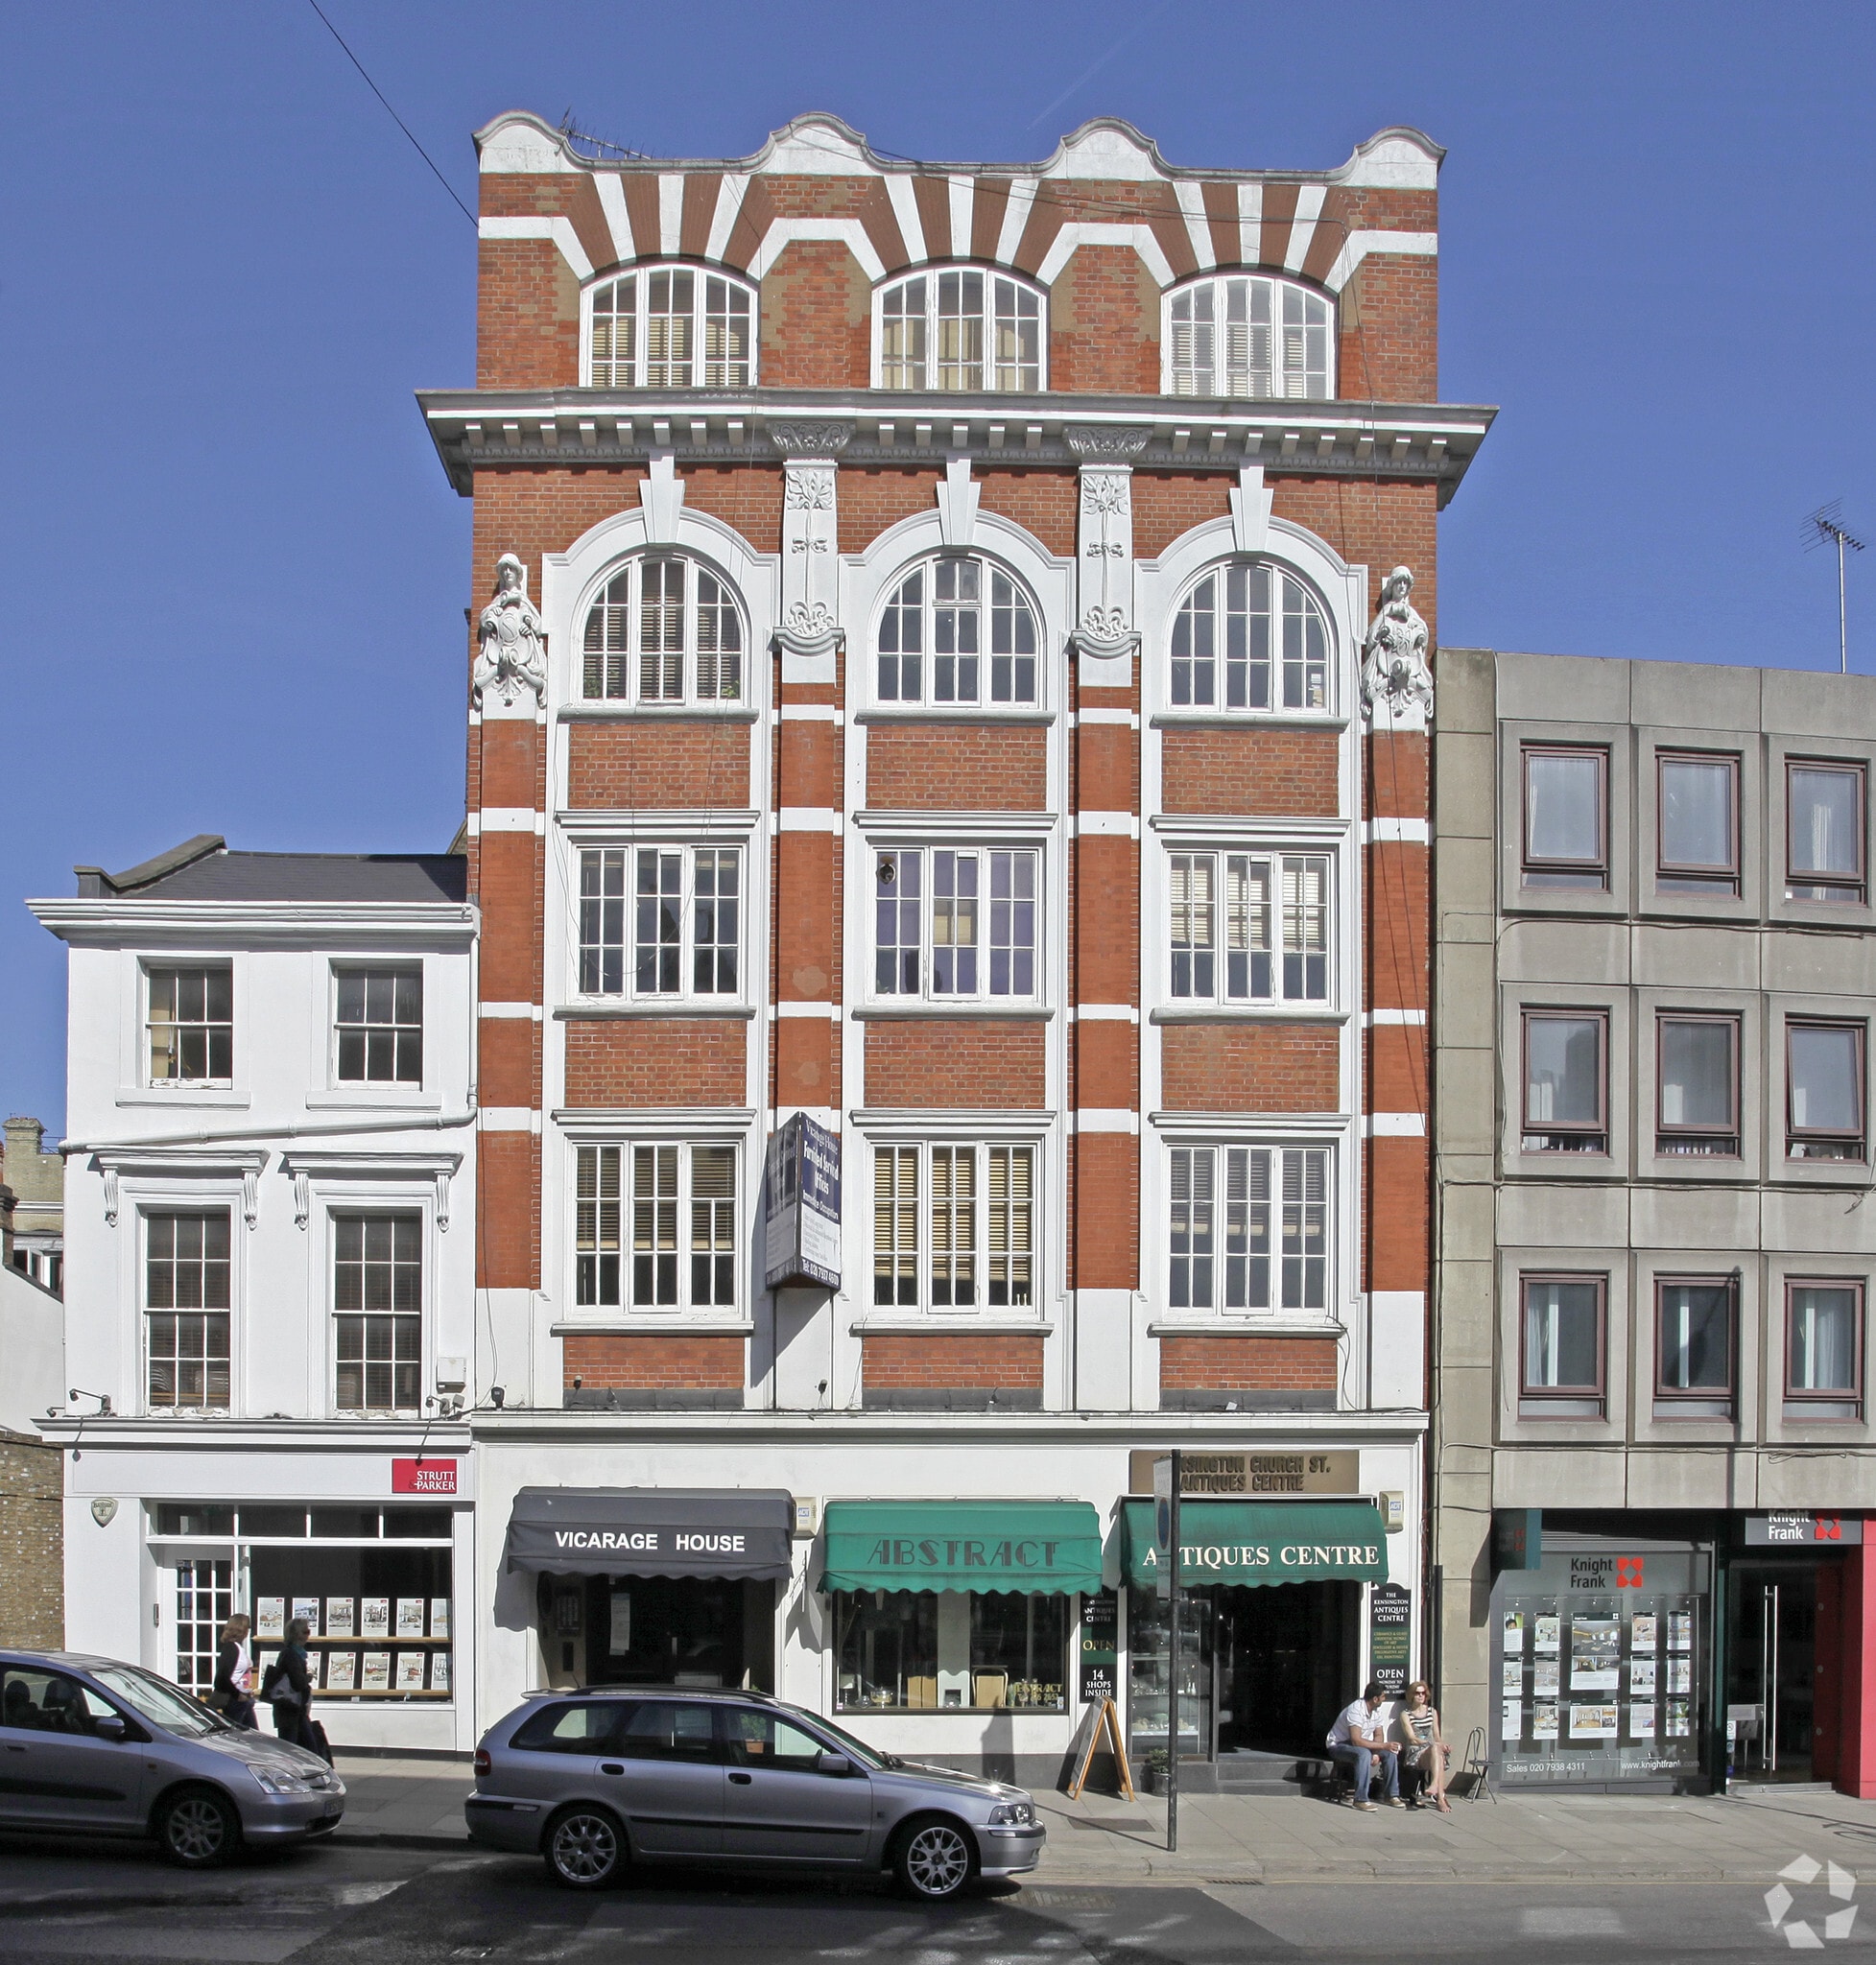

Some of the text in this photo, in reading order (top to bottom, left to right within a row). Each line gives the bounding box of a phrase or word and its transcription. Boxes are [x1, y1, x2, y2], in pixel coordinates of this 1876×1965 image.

[1250, 1456, 1304, 1473] CHURCH
[1309, 1456, 1331, 1473] ST.
[416, 1470, 455, 1480] STRUTT
[416, 1480, 456, 1490] PARKER
[1180, 1475, 1247, 1494] ANTIQUES
[1251, 1475, 1304, 1492] CENTRE
[1769, 1508, 1811, 1526] Knight
[1769, 1526, 1804, 1540] Frank
[555, 1531, 746, 1552] VICARAGE HOUSE
[867, 1539, 1060, 1567] ABSTRACT
[1143, 1546, 1270, 1569] ATIQUES
[1280, 1546, 1380, 1565] CENTRE
[1571, 1557, 1613, 1574] Knight
[1571, 1574, 1605, 1588] Frank
[1373, 1606, 1409, 1615] ANTIQUES
[1082, 1639, 1115, 1650] OPEN
[1092, 1669, 1104, 1680] 14
[1376, 1669, 1404, 1678] OPEN
[1507, 1762, 1585, 1773] Sales 020 7938 4311
[1621, 1759, 1700, 1771] www.knightfrank.com
